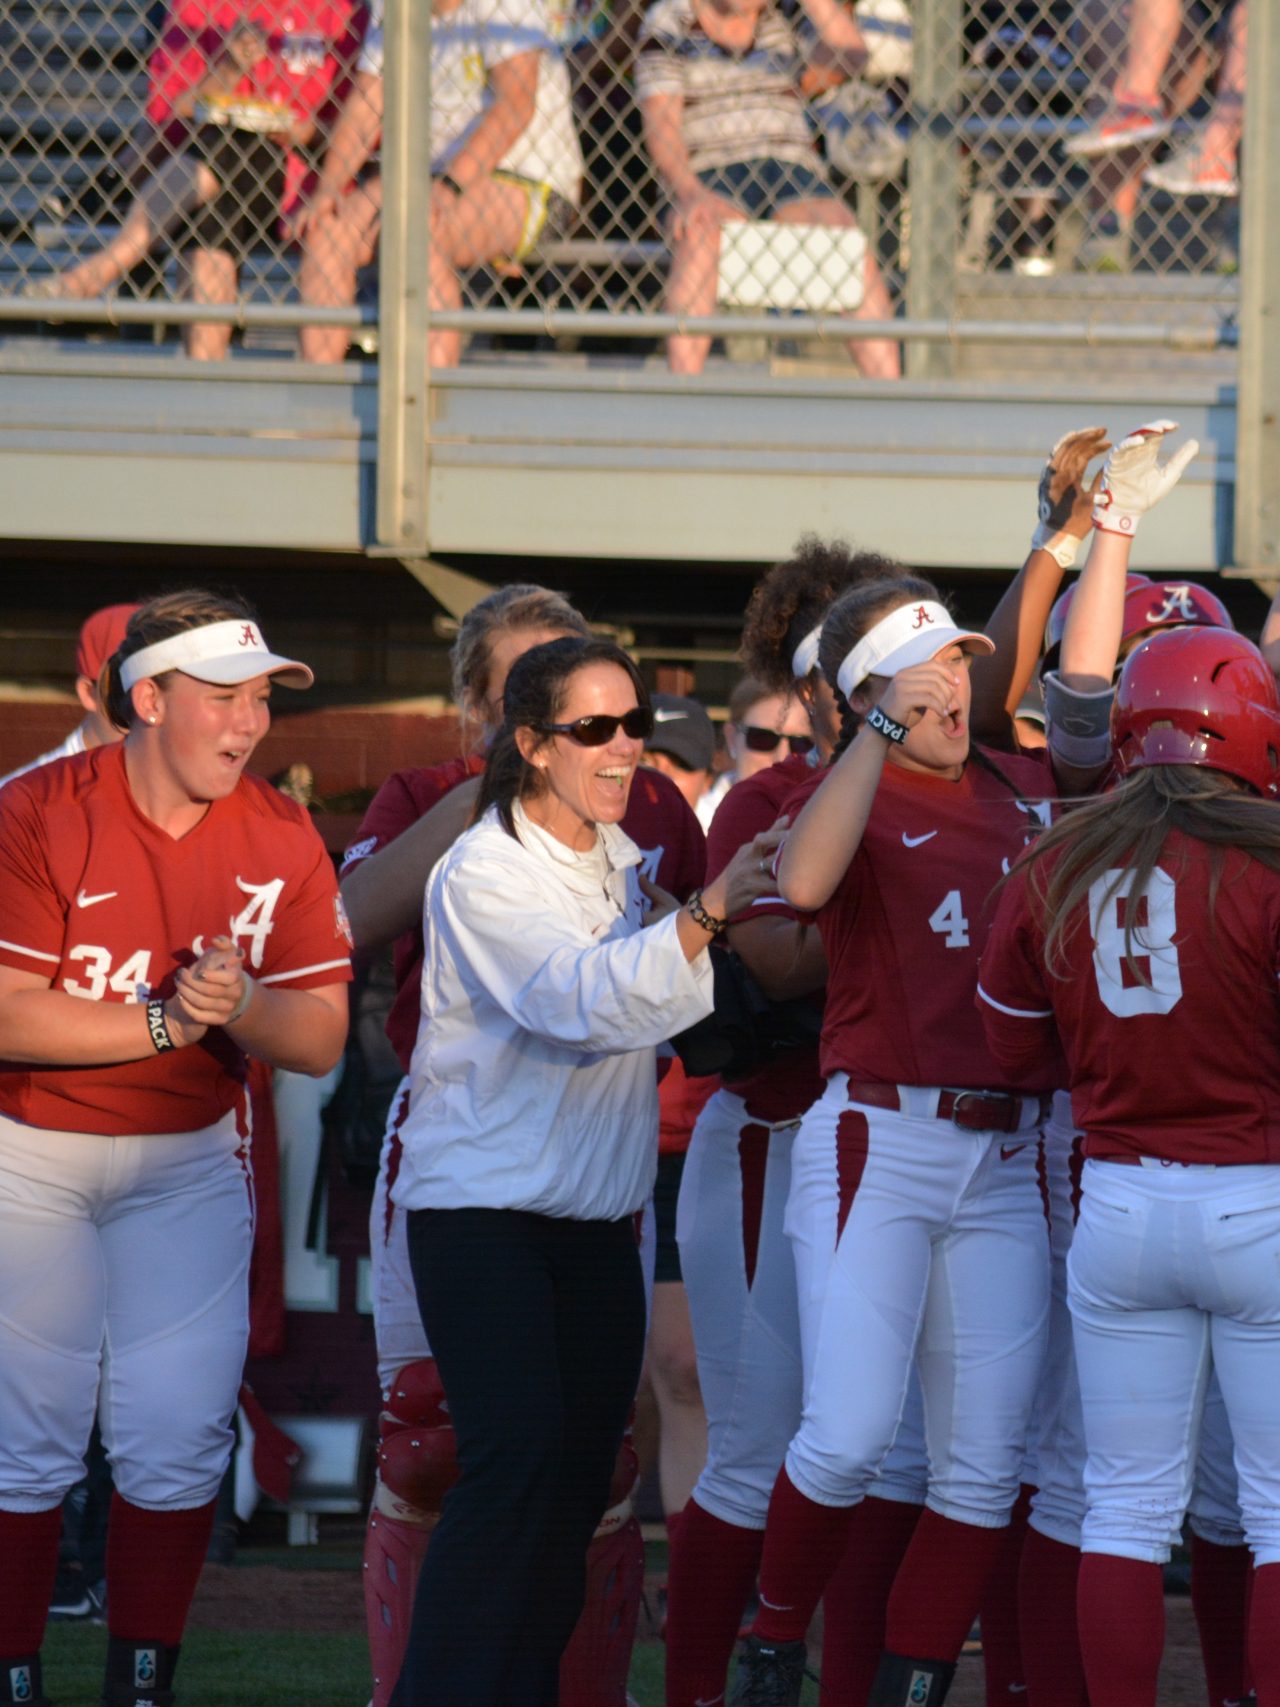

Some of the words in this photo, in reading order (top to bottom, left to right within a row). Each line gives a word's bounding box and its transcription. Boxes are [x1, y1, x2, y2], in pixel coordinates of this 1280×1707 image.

[912, 606, 934, 629] A
[1146, 585, 1197, 623] A
[238, 624, 258, 646] A
[928, 890, 970, 948] 4
[1088, 866, 1183, 1018] 8
[63, 944, 151, 1004] 34
[148, 1006, 171, 1049] PACK
